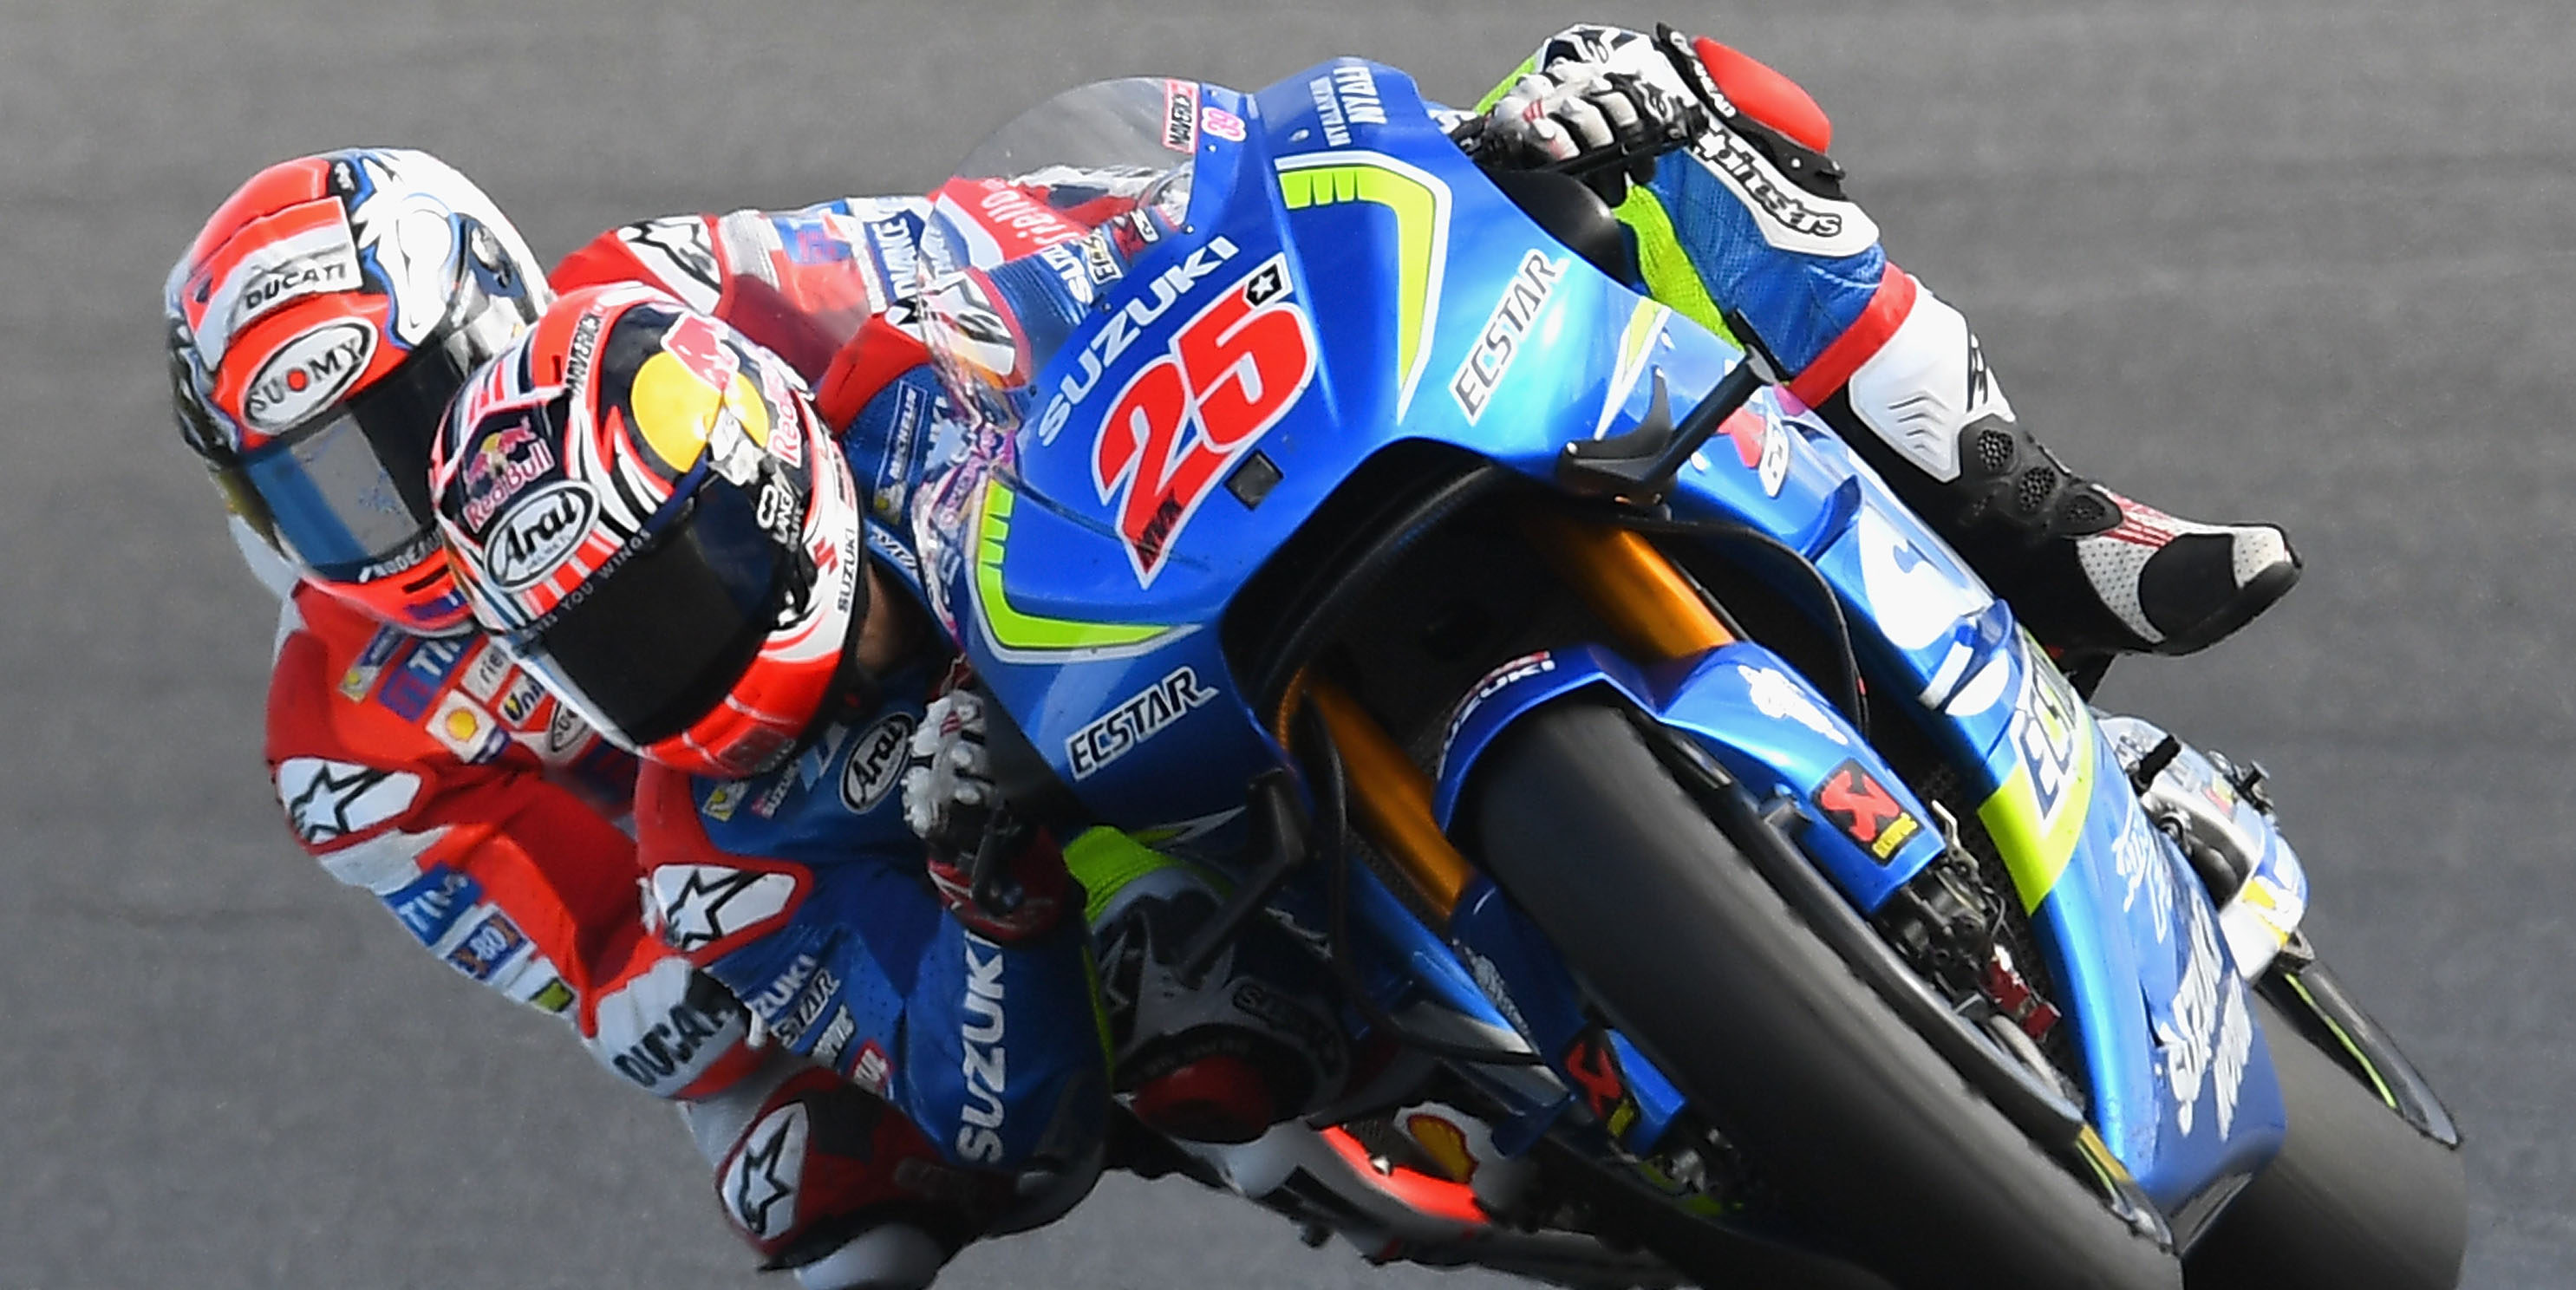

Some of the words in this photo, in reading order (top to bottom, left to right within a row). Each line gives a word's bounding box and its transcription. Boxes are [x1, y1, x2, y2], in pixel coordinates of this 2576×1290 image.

[245, 262, 346, 309] DUCATI
[248, 336, 362, 412] SUOMY
[1039, 236, 1240, 447] SUZUKI
[1452, 251, 1562, 420] ECSTAR
[1092, 257, 1314, 584] 25
[462, 476, 511, 535] Red
[504, 436, 556, 497] Bull
[499, 489, 578, 581] Arai
[837, 526, 857, 614] SUZUKI
[560, 581, 594, 610] YOU
[851, 722, 903, 806] Arai
[1067, 668, 1206, 777] ECSTAR
[955, 928, 1006, 1163] SUZUKI
